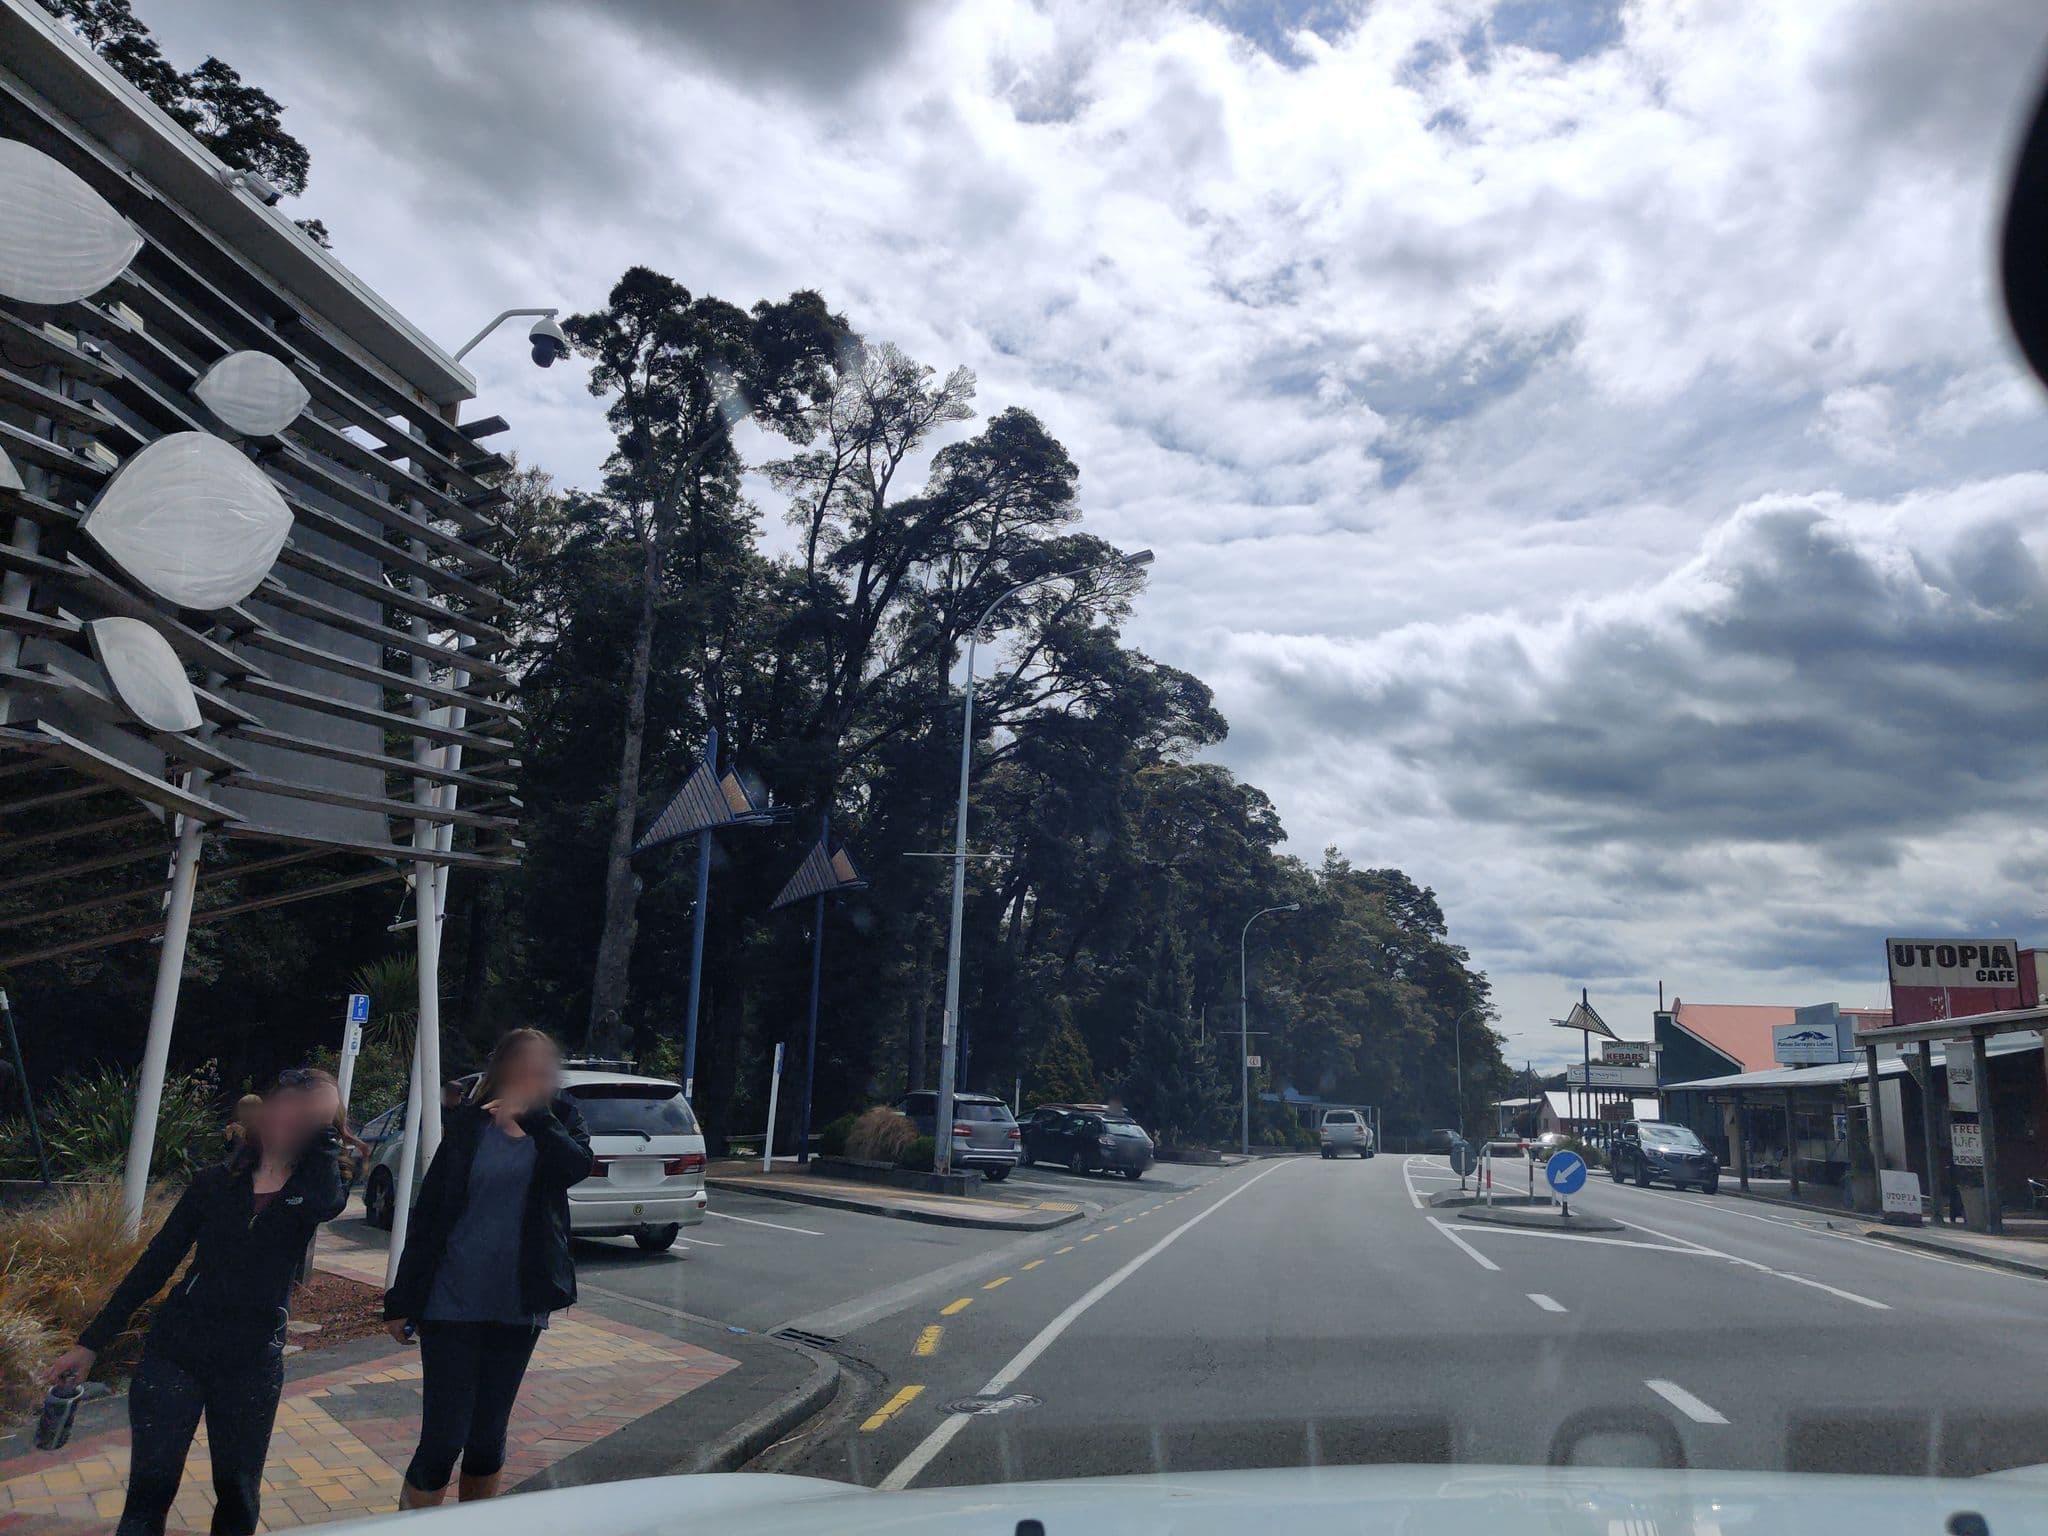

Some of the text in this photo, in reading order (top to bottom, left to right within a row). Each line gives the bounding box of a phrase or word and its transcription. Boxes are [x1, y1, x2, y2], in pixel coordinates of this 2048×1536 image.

[1894, 945, 2013, 968] UTOPIA
[1975, 970, 2015, 982] CAFE
[358, 996, 365, 1007] P
[1952, 1125, 1980, 1134] FREE
[1953, 1155, 1984, 1165] PURCHASE
[1886, 1192, 1917, 1201] UTOPIA
